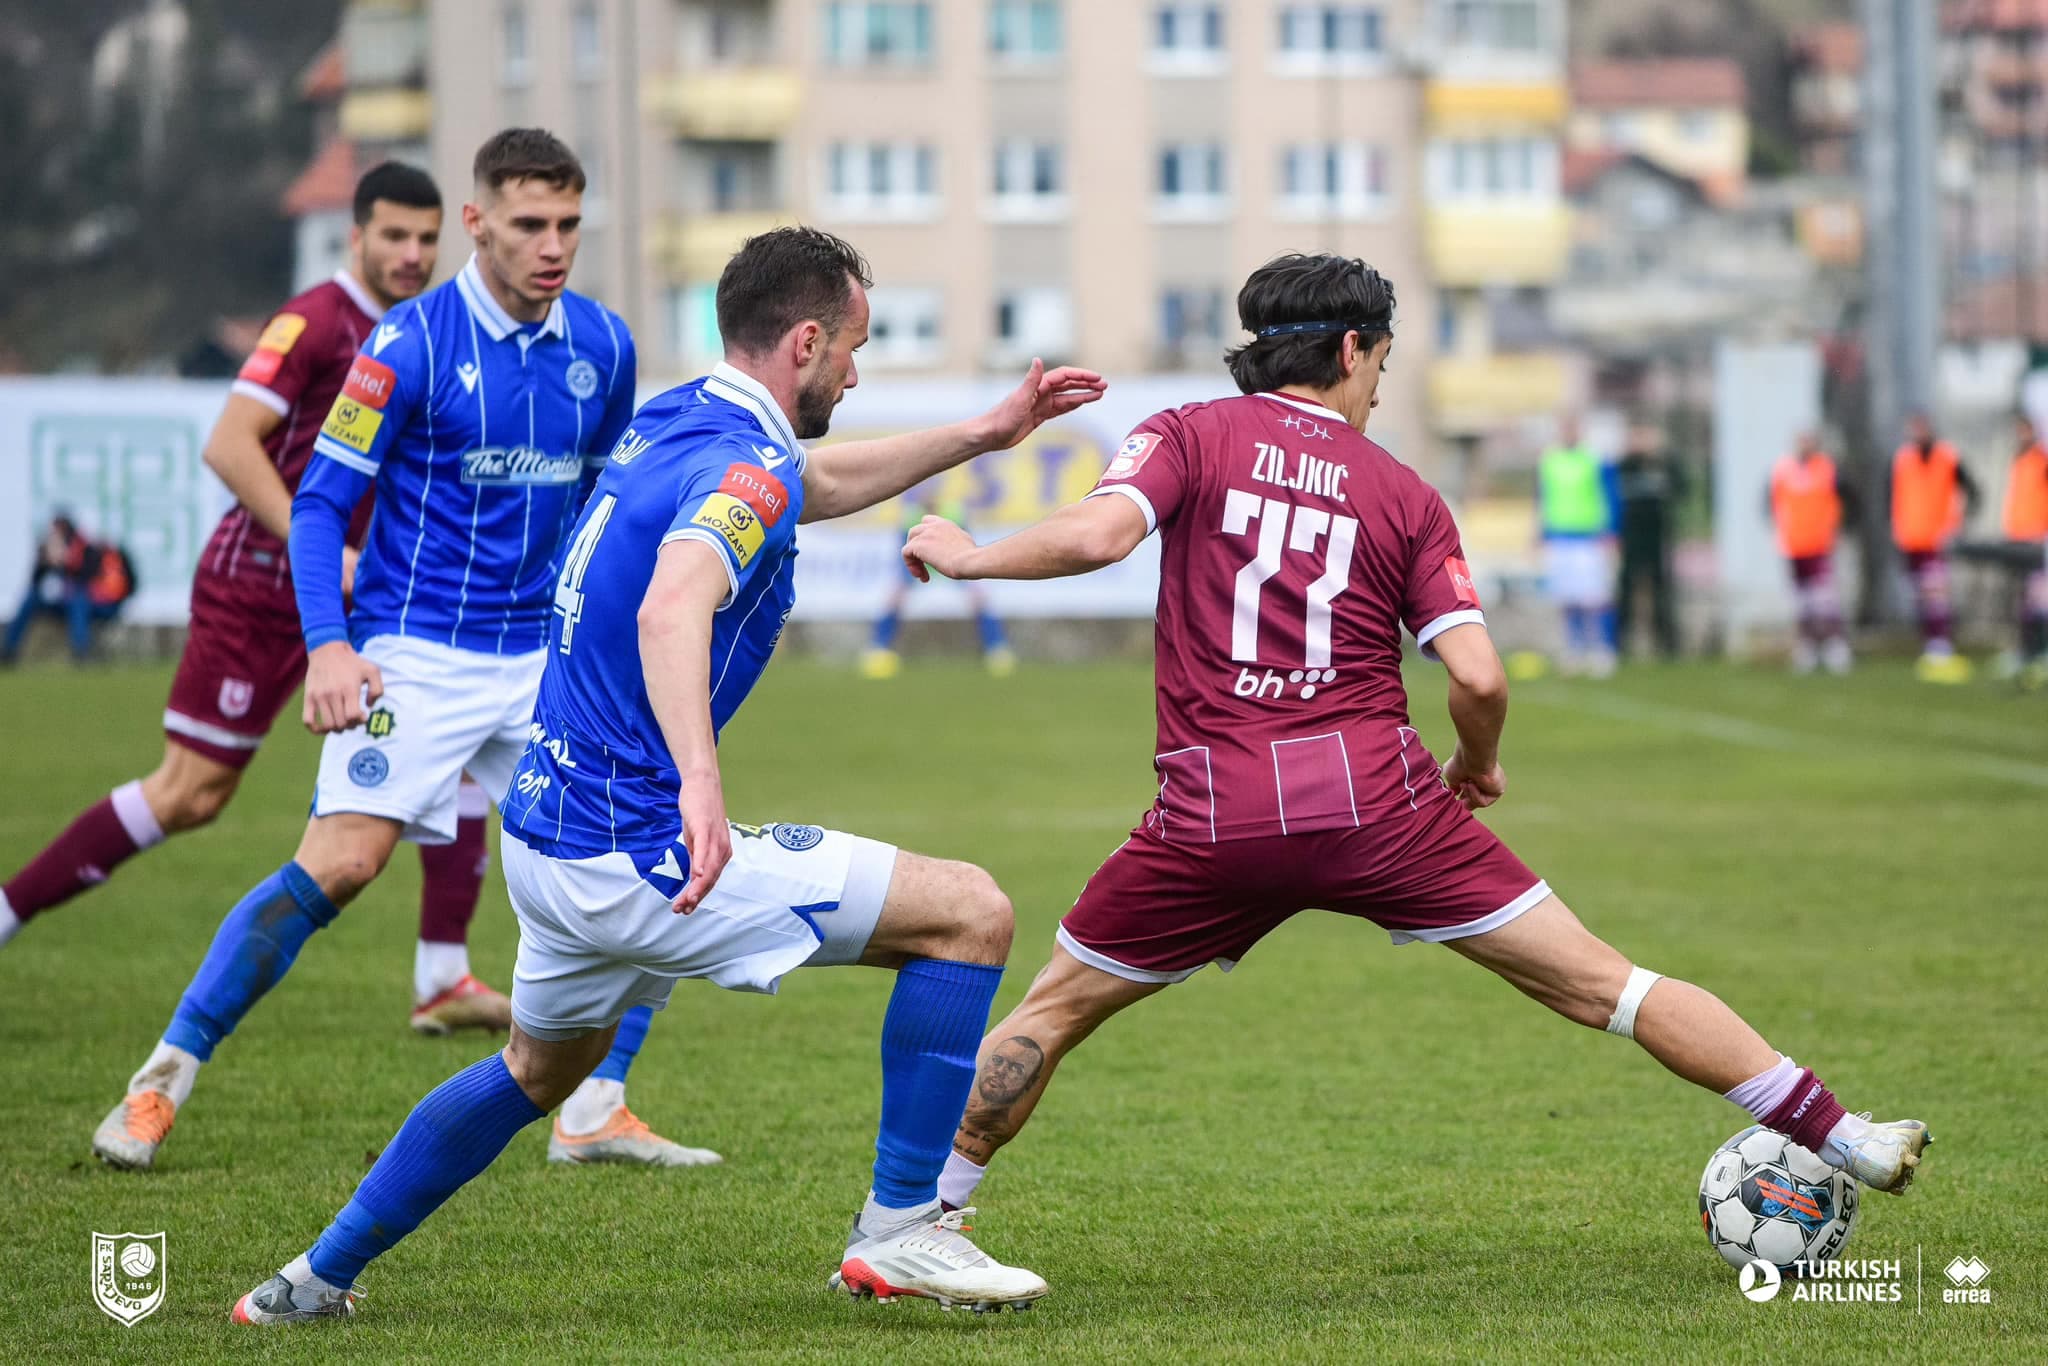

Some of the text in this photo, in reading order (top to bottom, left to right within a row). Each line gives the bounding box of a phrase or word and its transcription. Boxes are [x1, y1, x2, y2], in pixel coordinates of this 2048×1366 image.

[463, 448, 506, 477] The
[1251, 442, 1350, 502] ZILJKIĆ
[732, 471, 781, 515] m:tel
[699, 515, 748, 560] MOZZART
[553, 494, 617, 656] 4
[1221, 488, 1359, 668] 77
[1234, 667, 1285, 699] bh
[1817, 1179, 1855, 1260] SELECT
